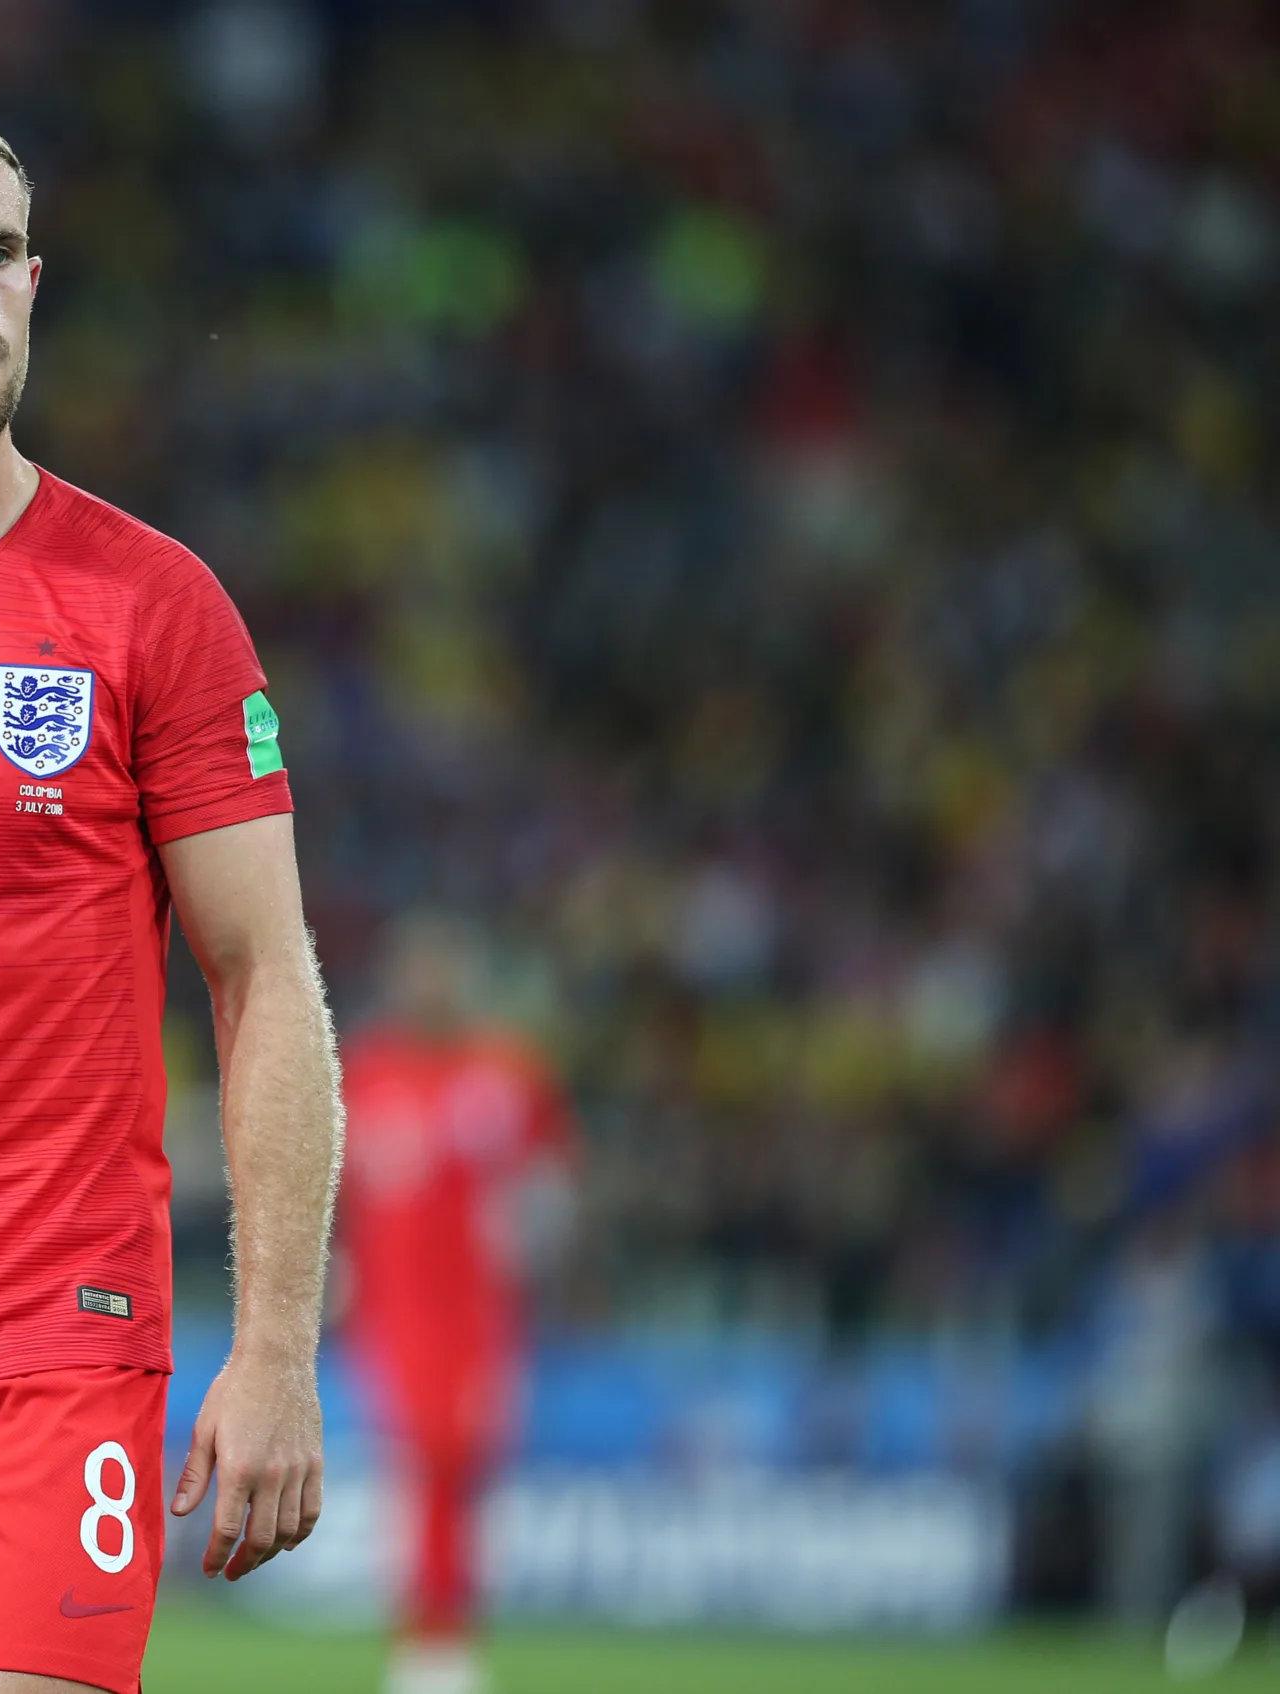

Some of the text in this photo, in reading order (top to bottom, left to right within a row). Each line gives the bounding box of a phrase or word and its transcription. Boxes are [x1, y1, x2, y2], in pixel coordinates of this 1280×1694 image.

[19, 784, 63, 799] COLOMBIA
[15, 800, 64, 816] 3 JULY 2018
[79, 1440, 136, 1574] 8
